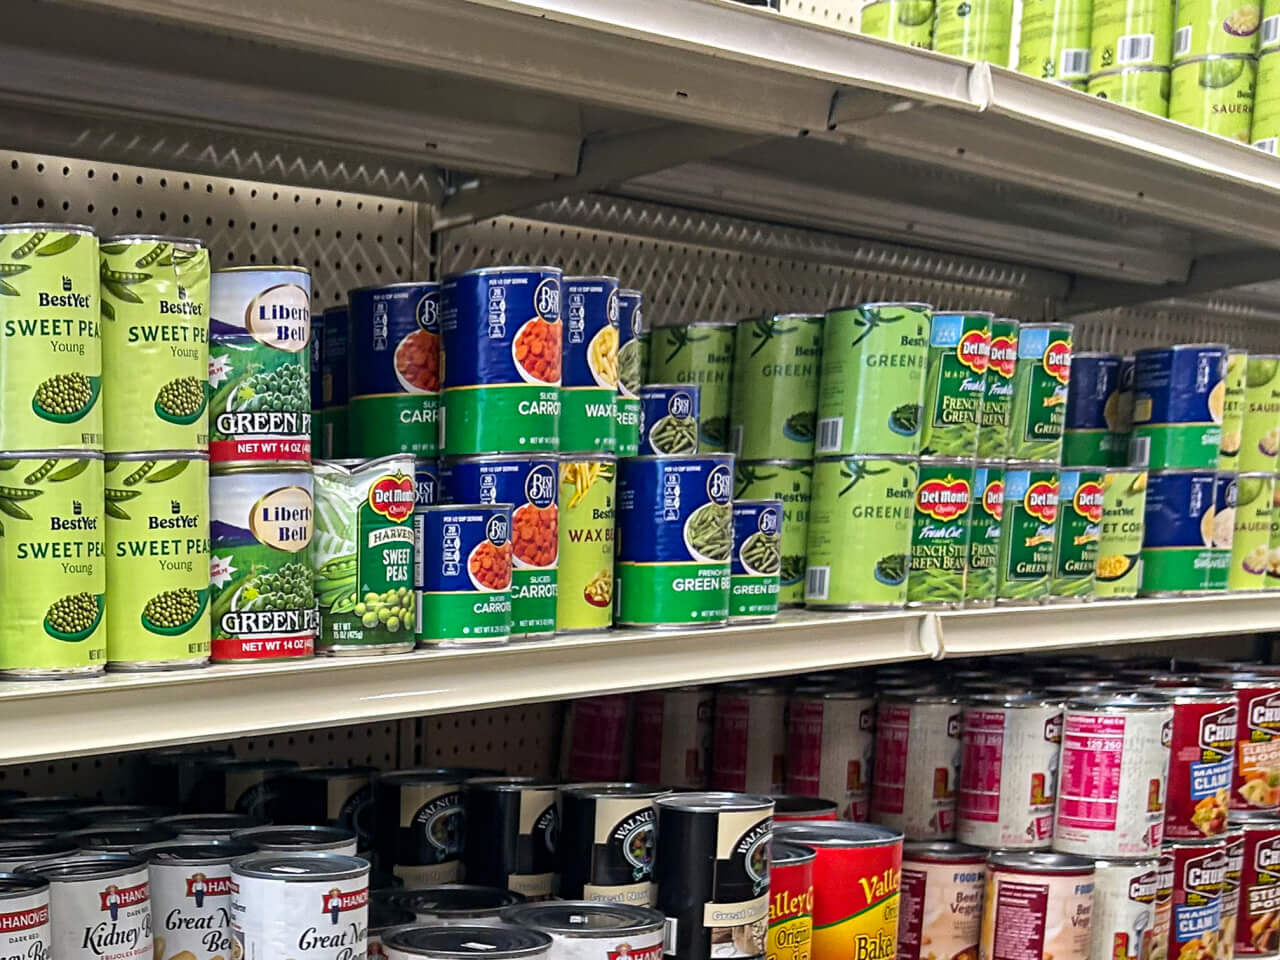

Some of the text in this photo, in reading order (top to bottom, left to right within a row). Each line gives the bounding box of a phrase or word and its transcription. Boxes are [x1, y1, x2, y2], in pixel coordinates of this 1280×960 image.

[39, 292, 90, 308] BestYet
[160, 301, 202, 316] BestYet
[866, 354, 916, 367] GREEN
[238, 443, 301, 453] NET WT 14 OZ
[921, 491, 936, 503] Del
[279, 527, 307, 541] Bell
[569, 529, 601, 542] WAX
[383, 549, 410, 565] SWEET
[672, 579, 718, 591] GREEN
[222, 611, 299, 633] GREEN
[242, 640, 304, 651] NET WT 14 OZ
[2, 909, 48, 928] HANOVER
[166, 909, 211, 930] Great
[82, 922, 141, 955] Kidney
[299, 928, 346, 950] Great
